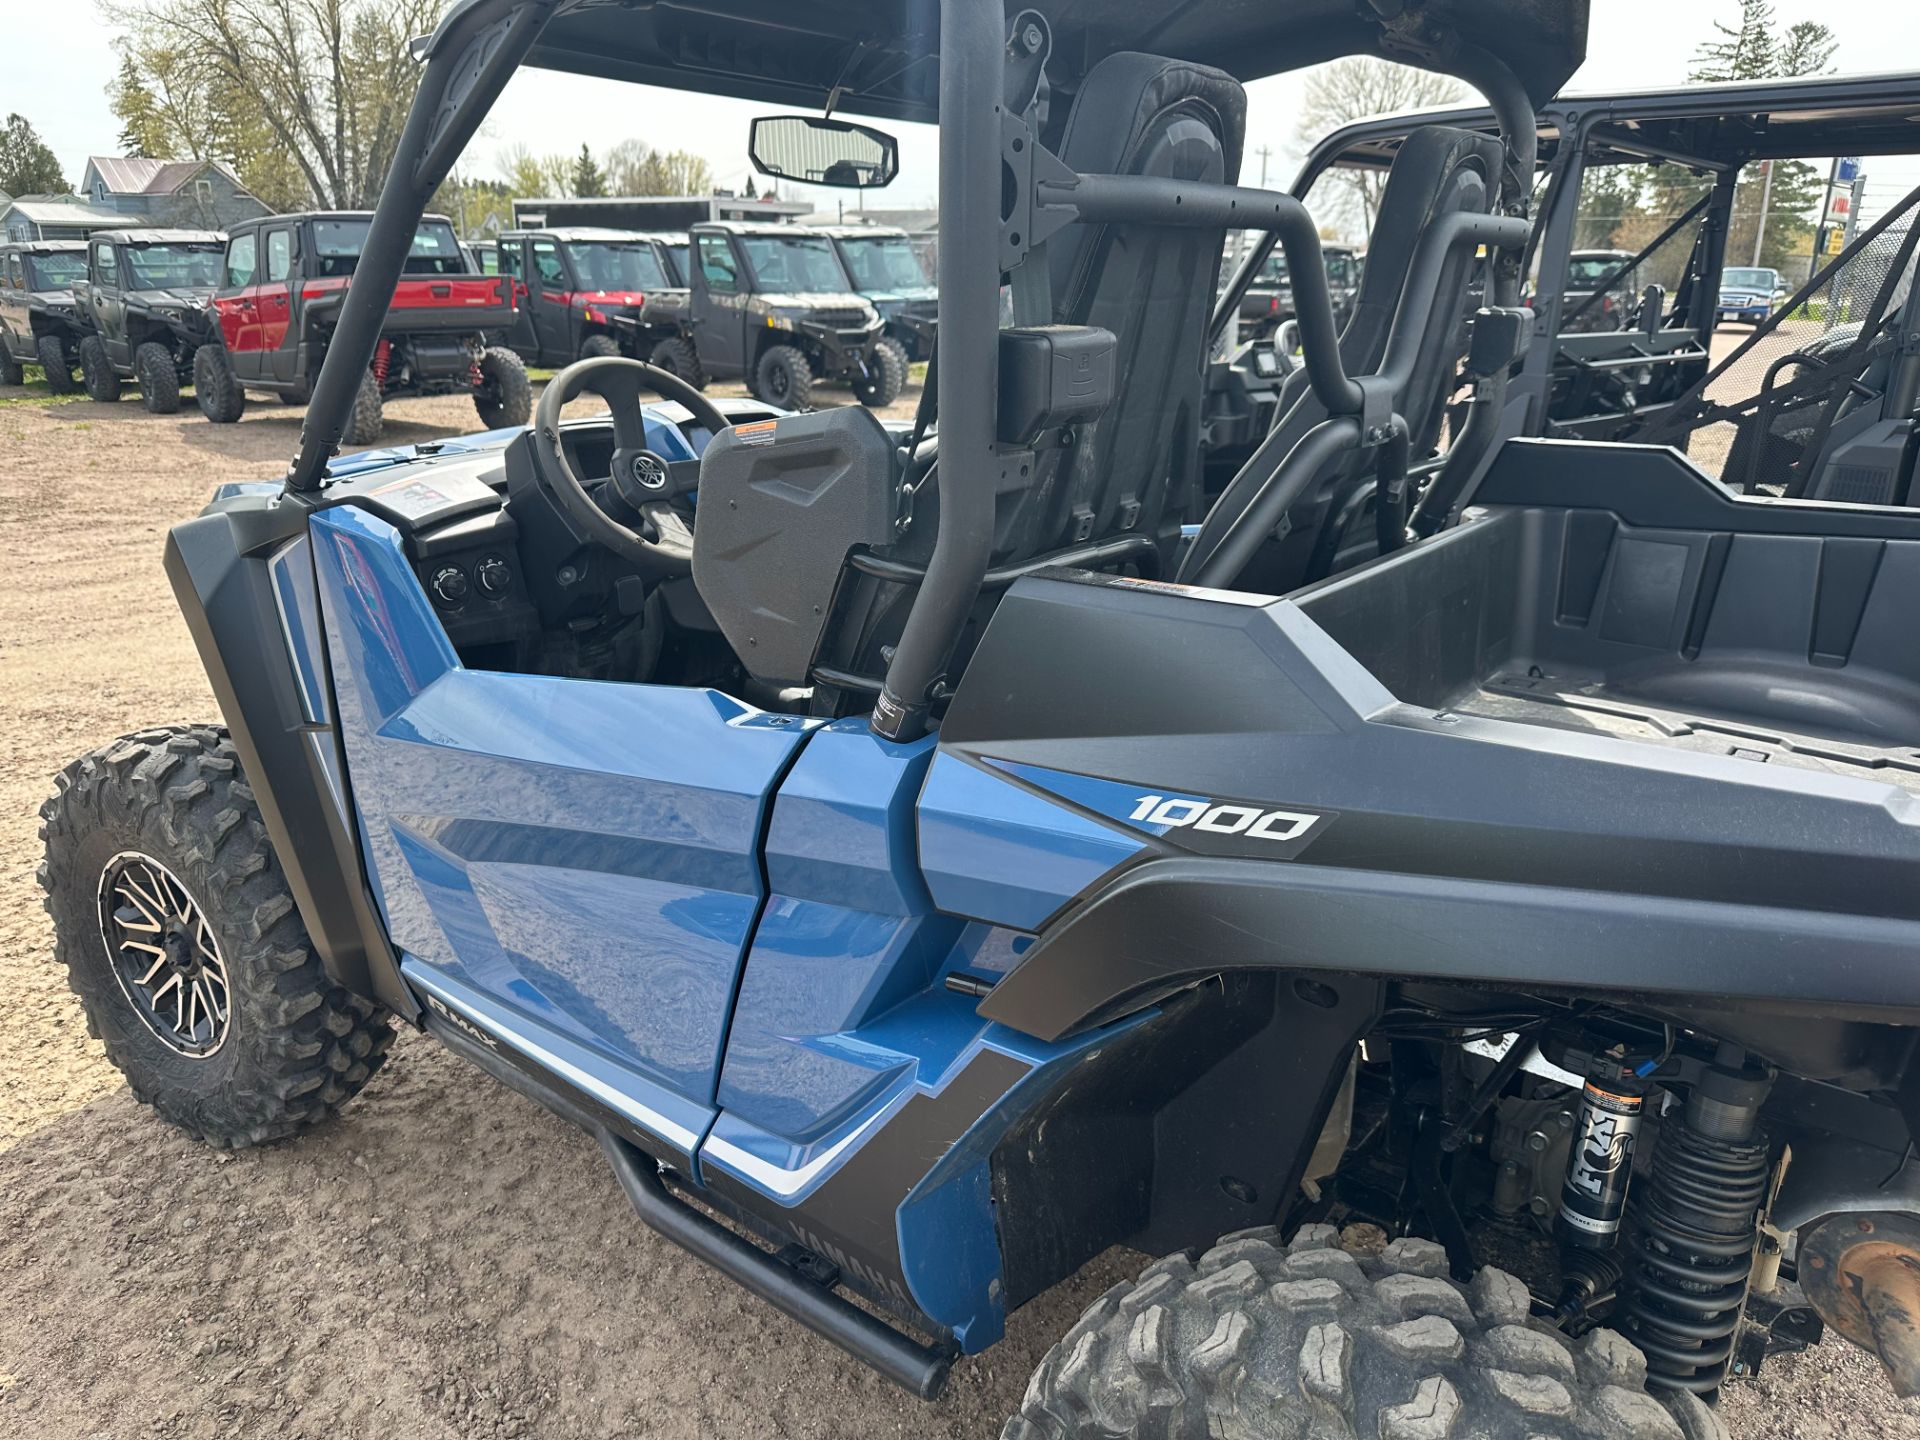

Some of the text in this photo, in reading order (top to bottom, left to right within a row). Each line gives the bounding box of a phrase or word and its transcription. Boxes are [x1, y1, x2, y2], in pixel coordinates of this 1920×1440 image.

[1128, 794, 1321, 841] 1000
[427, 994, 498, 1051] RMAX
[1571, 1108, 1621, 1196] FOX
[787, 1219, 912, 1307] YAMAHA
